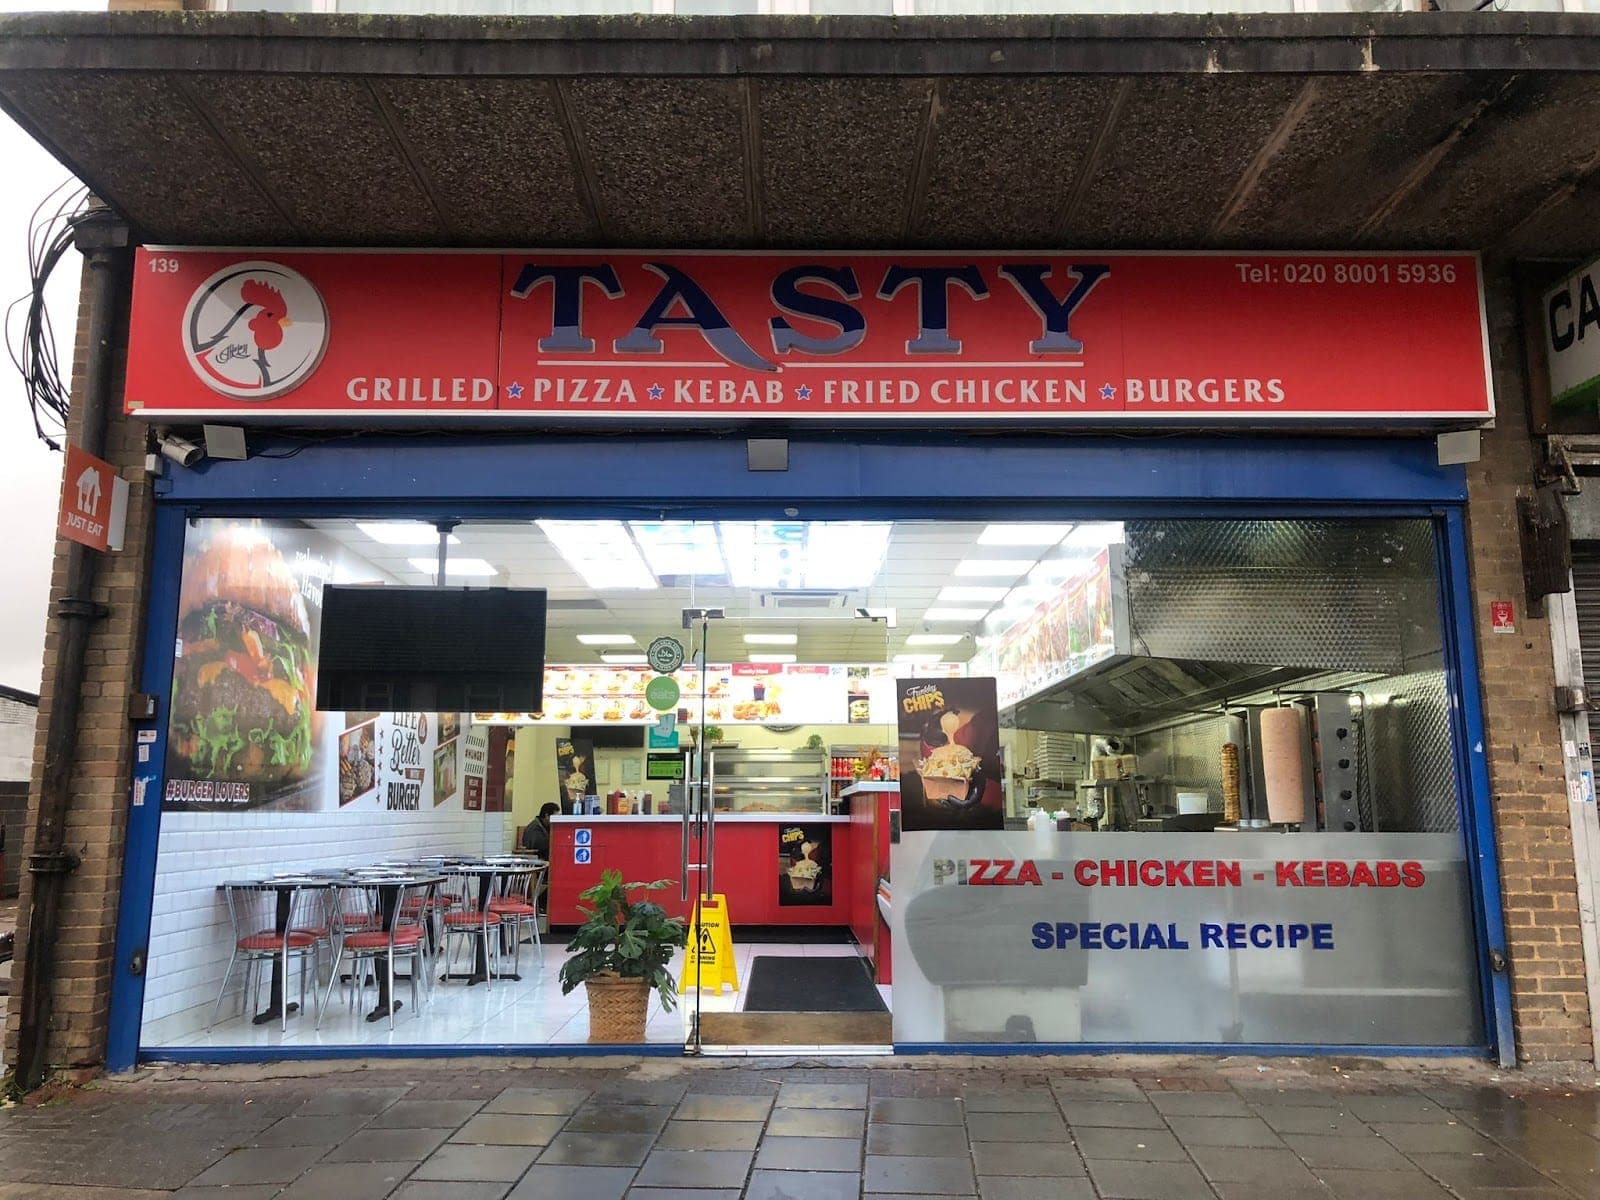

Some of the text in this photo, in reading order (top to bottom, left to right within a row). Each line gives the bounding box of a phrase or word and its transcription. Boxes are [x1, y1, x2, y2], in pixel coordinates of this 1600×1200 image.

[149, 258, 179, 273] 139
[1236, 264, 1456, 284] Tel: 020 8001 5936
[510, 263, 1111, 374] TASTY
[346, 377, 1285, 404] GRILLED PIZZA KEBAB FRIED CHICKEN BURGERS
[65, 511, 104, 536] JUST EAT
[902, 691, 945, 714] CHIPS
[165, 779, 214, 802] #BURGER
[214, 781, 250, 802] LOVERS
[387, 781, 421, 811] BURGER
[933, 858, 1043, 886] PIZZA
[1074, 859, 1242, 887] CHICKEN
[1275, 860, 1425, 888] KEBABS
[1032, 922, 1334, 950] SPECIAL RECIPE
